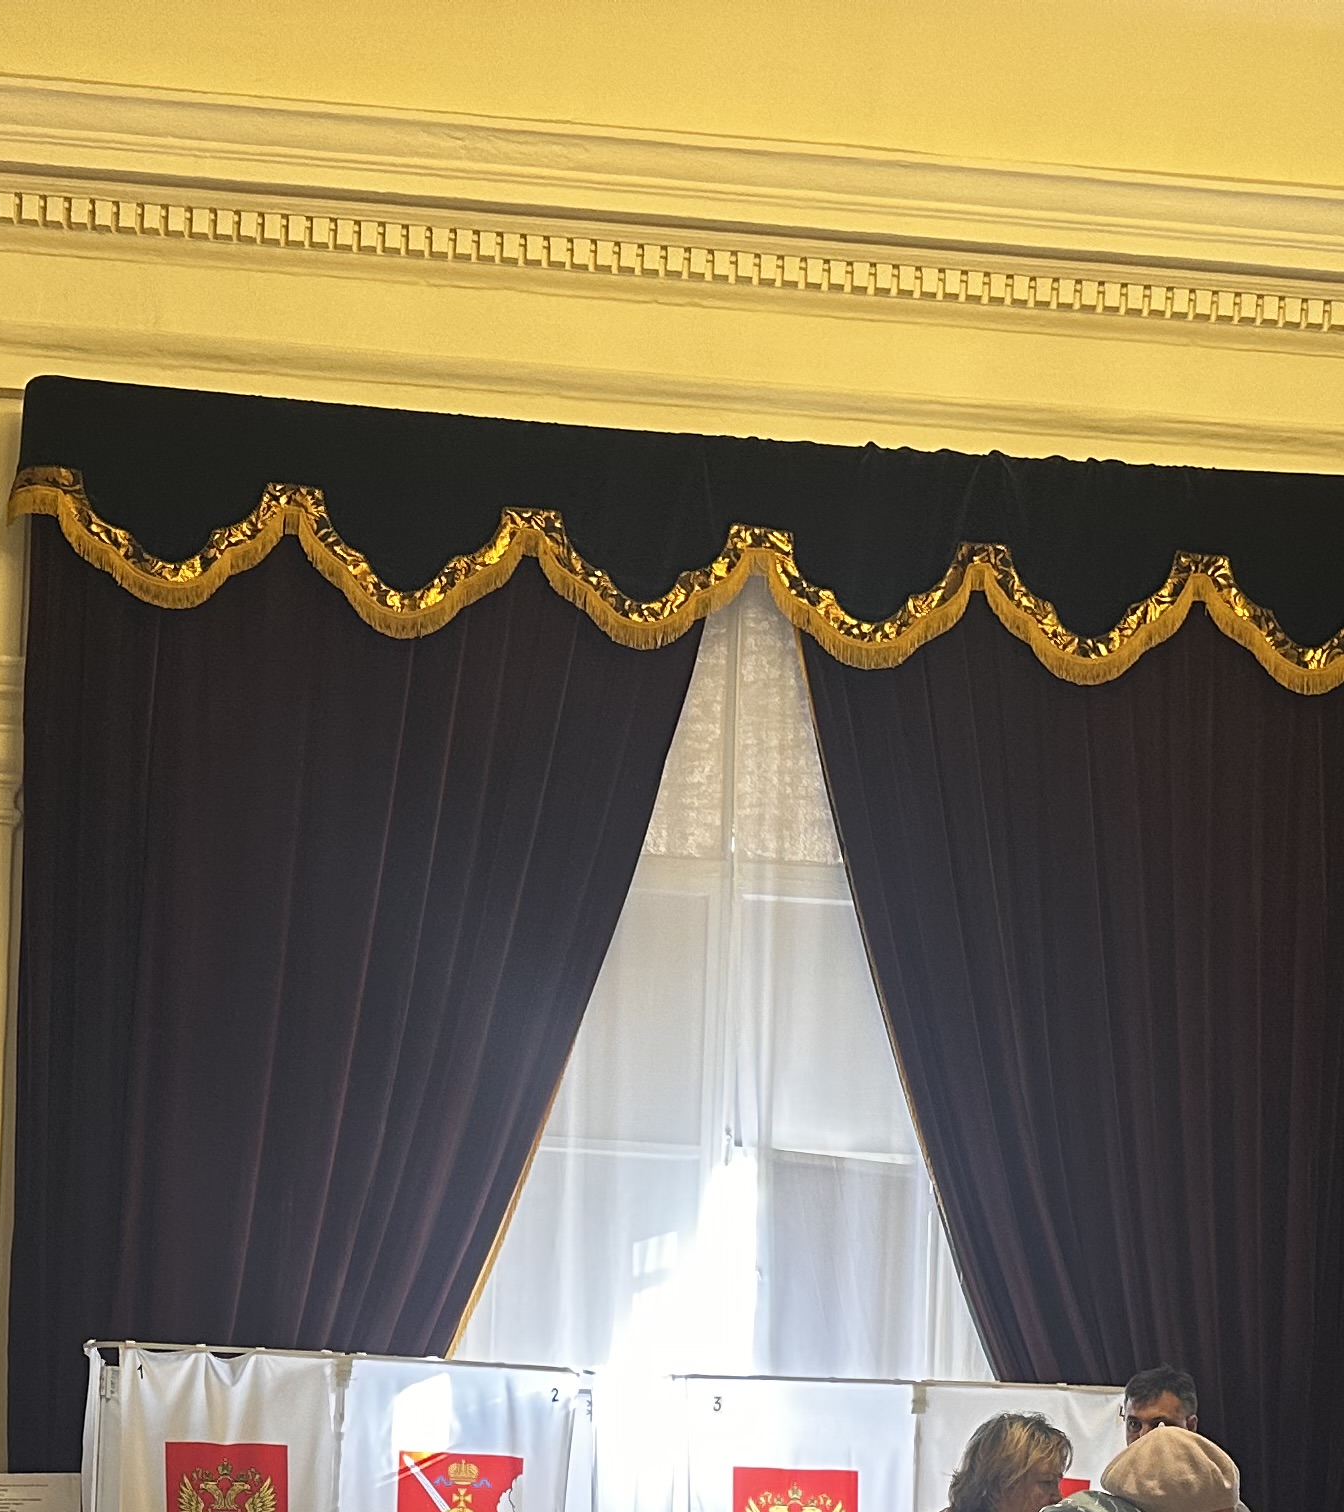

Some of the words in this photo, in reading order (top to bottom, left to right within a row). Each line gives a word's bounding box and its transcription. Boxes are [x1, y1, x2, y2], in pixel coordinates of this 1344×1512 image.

[136, 1364, 144, 1380] 1
[551, 1387, 560, 1402] 2
[713, 1396, 722, 1412] 3
